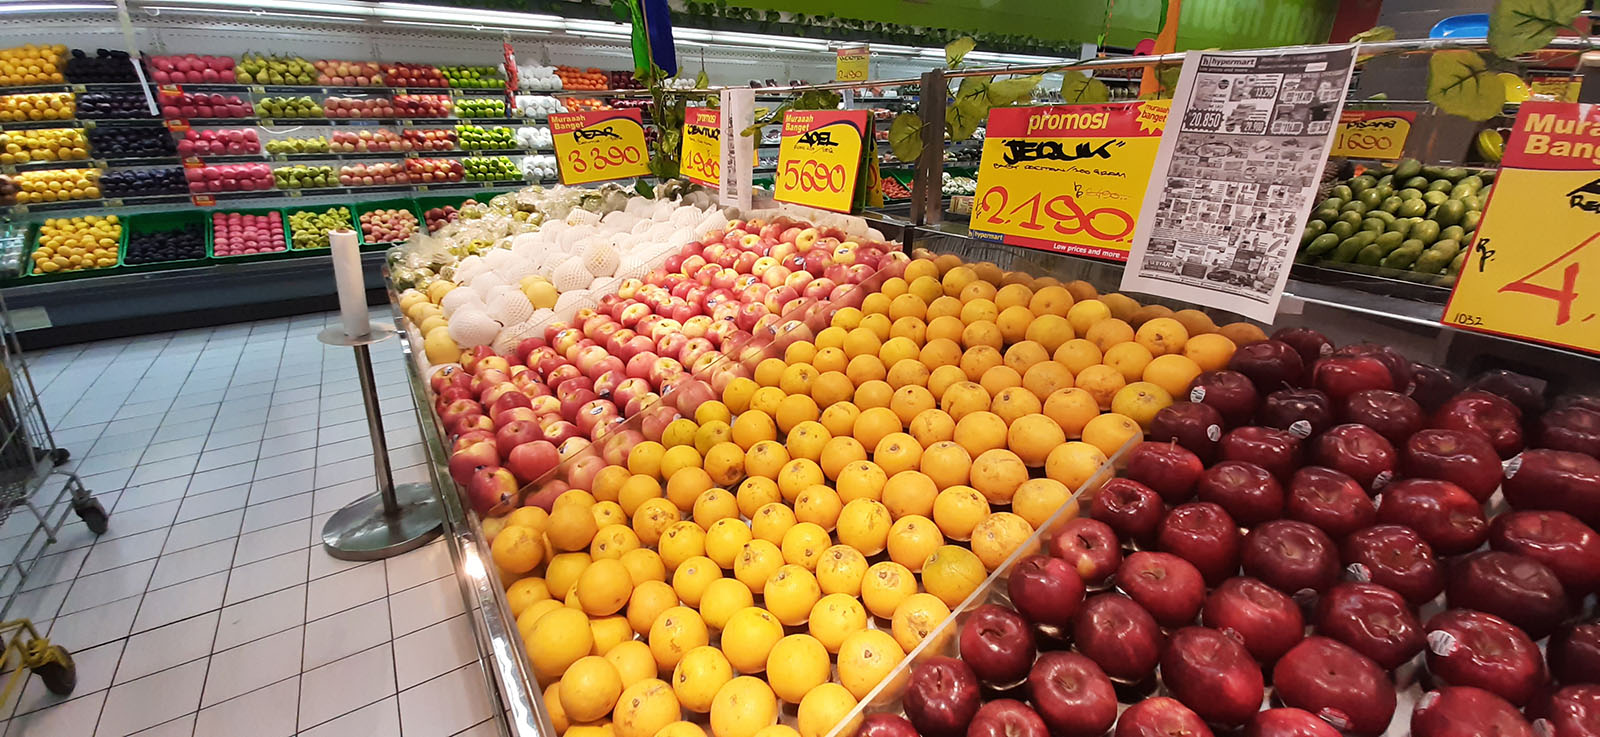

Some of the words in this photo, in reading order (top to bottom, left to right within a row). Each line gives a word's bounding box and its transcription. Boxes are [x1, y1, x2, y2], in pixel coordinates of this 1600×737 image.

[1211, 58, 1255, 66] hypermart
[1141, 110, 1167, 123] banget
[553, 122, 585, 131] Banget
[785, 123, 810, 133] Banget
[1026, 112, 1109, 136] promosi
[573, 126, 623, 143] PEAR
[974, 231, 1003, 241] hypermart
[1053, 243, 1067, 251] Low
[1067, 244, 1087, 255] prices
[1088, 247, 1101, 256] and
[1102, 250, 1121, 259] more
[1453, 312, 1484, 326] 1032
